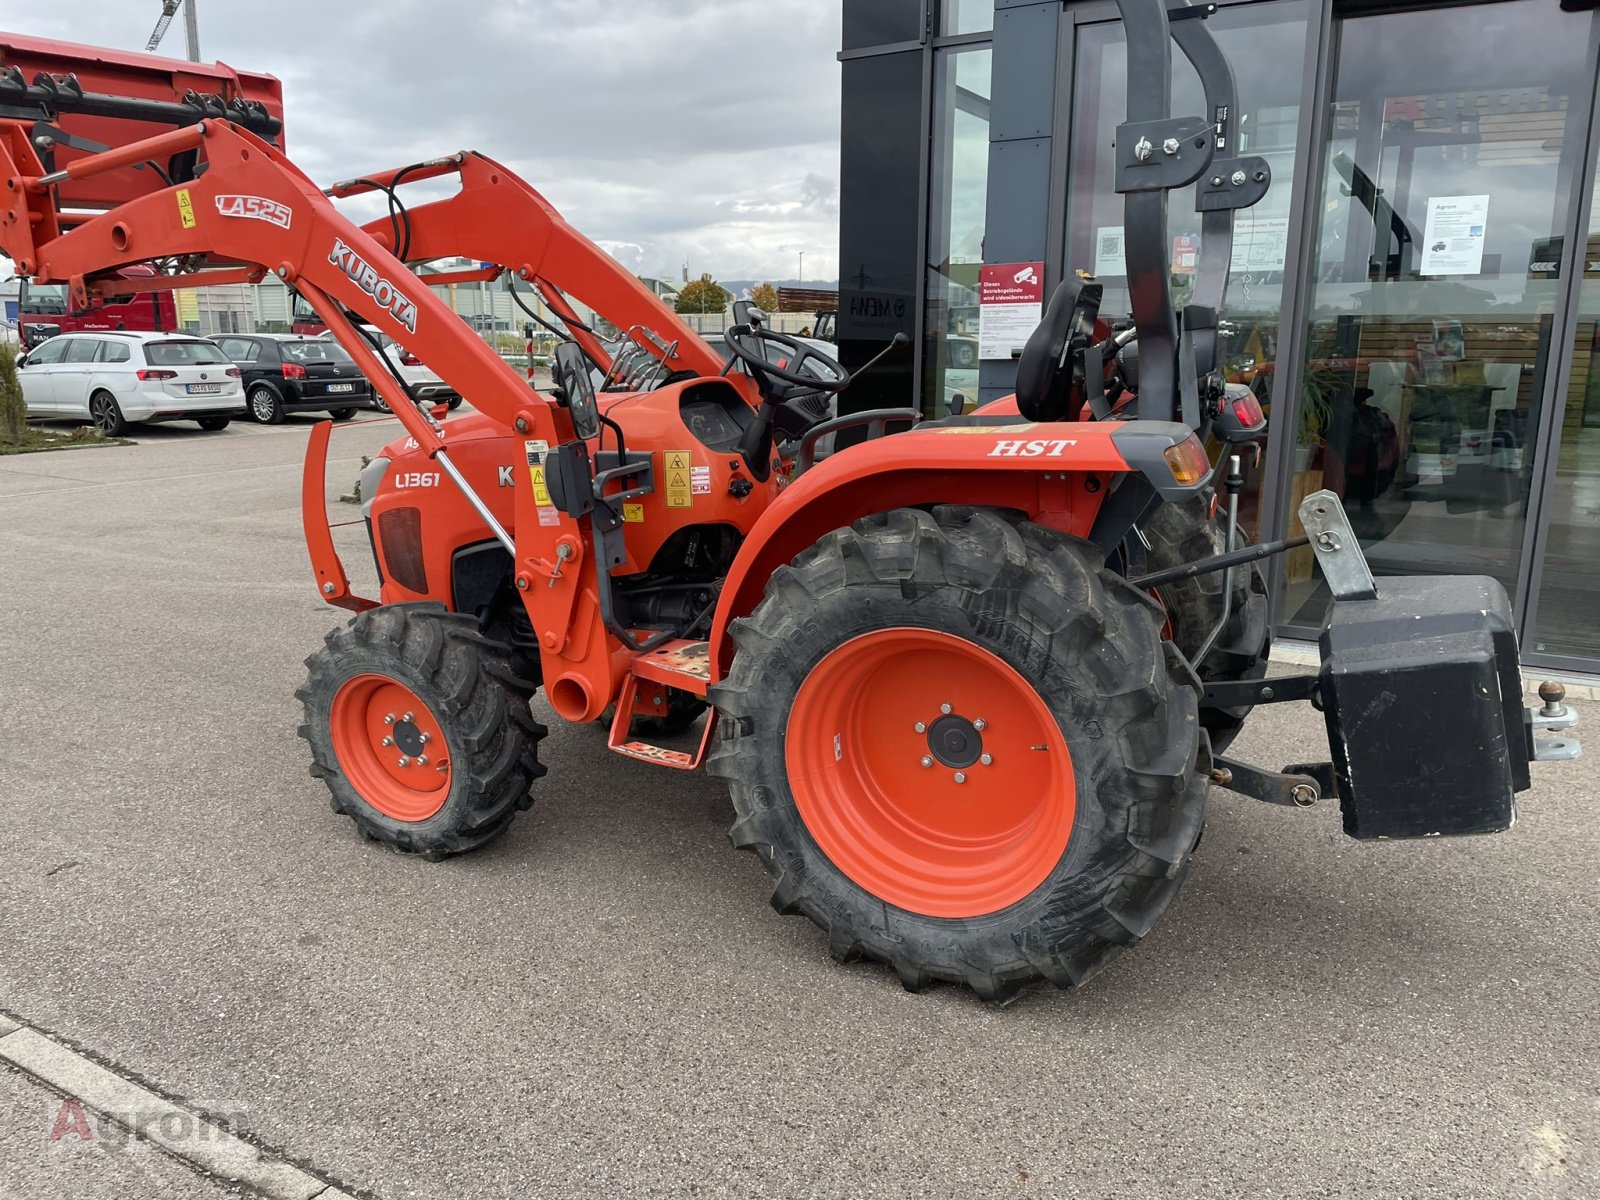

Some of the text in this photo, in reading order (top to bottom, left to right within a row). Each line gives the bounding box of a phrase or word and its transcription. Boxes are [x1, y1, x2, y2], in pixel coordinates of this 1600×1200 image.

[219, 197, 290, 225] LA525
[328, 238, 417, 333] KUBOTA
[983, 287, 1023, 295] Betriebsgelände
[986, 439, 1078, 457] HST
[395, 472, 440, 488] L1361
